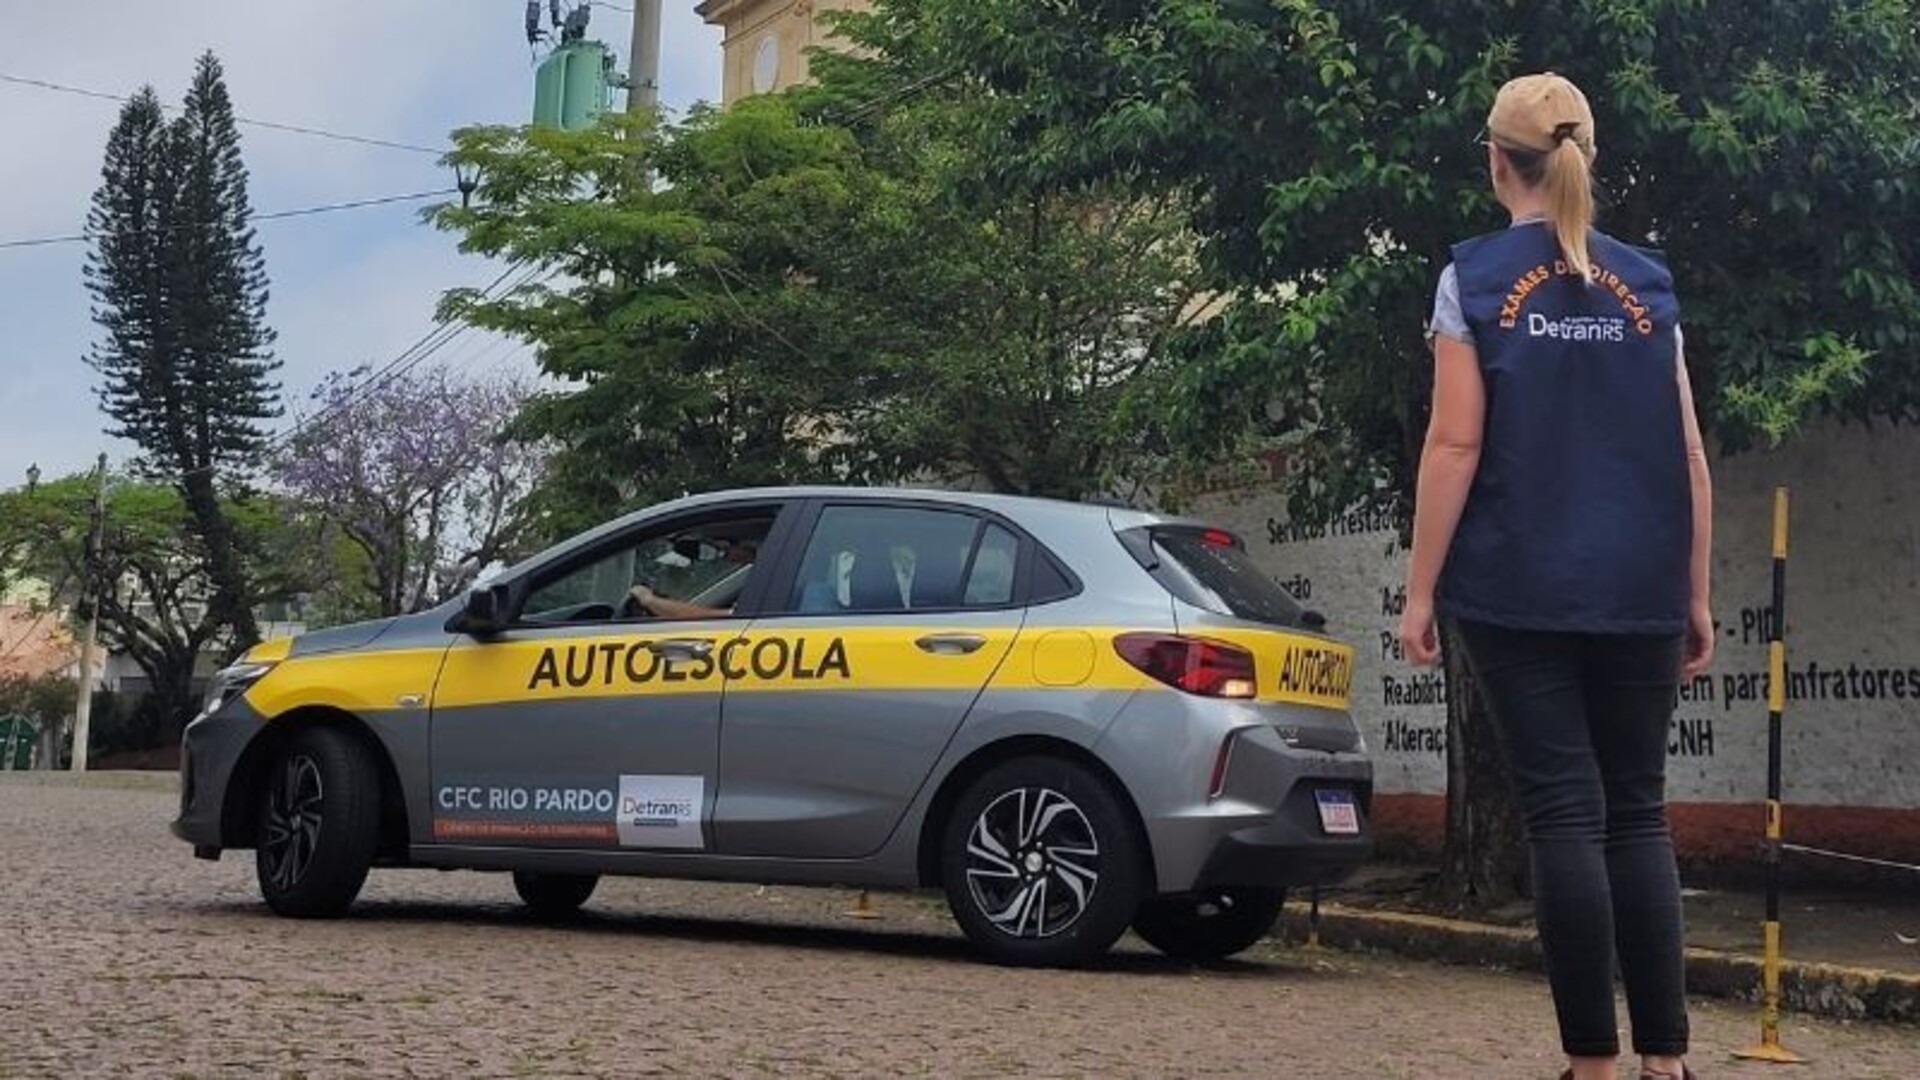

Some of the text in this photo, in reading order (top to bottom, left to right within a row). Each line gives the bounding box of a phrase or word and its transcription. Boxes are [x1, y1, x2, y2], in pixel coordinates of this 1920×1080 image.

[1500, 265, 1549, 328] EXAMES
[438, 786, 613, 812] CFC RIO PARDO
